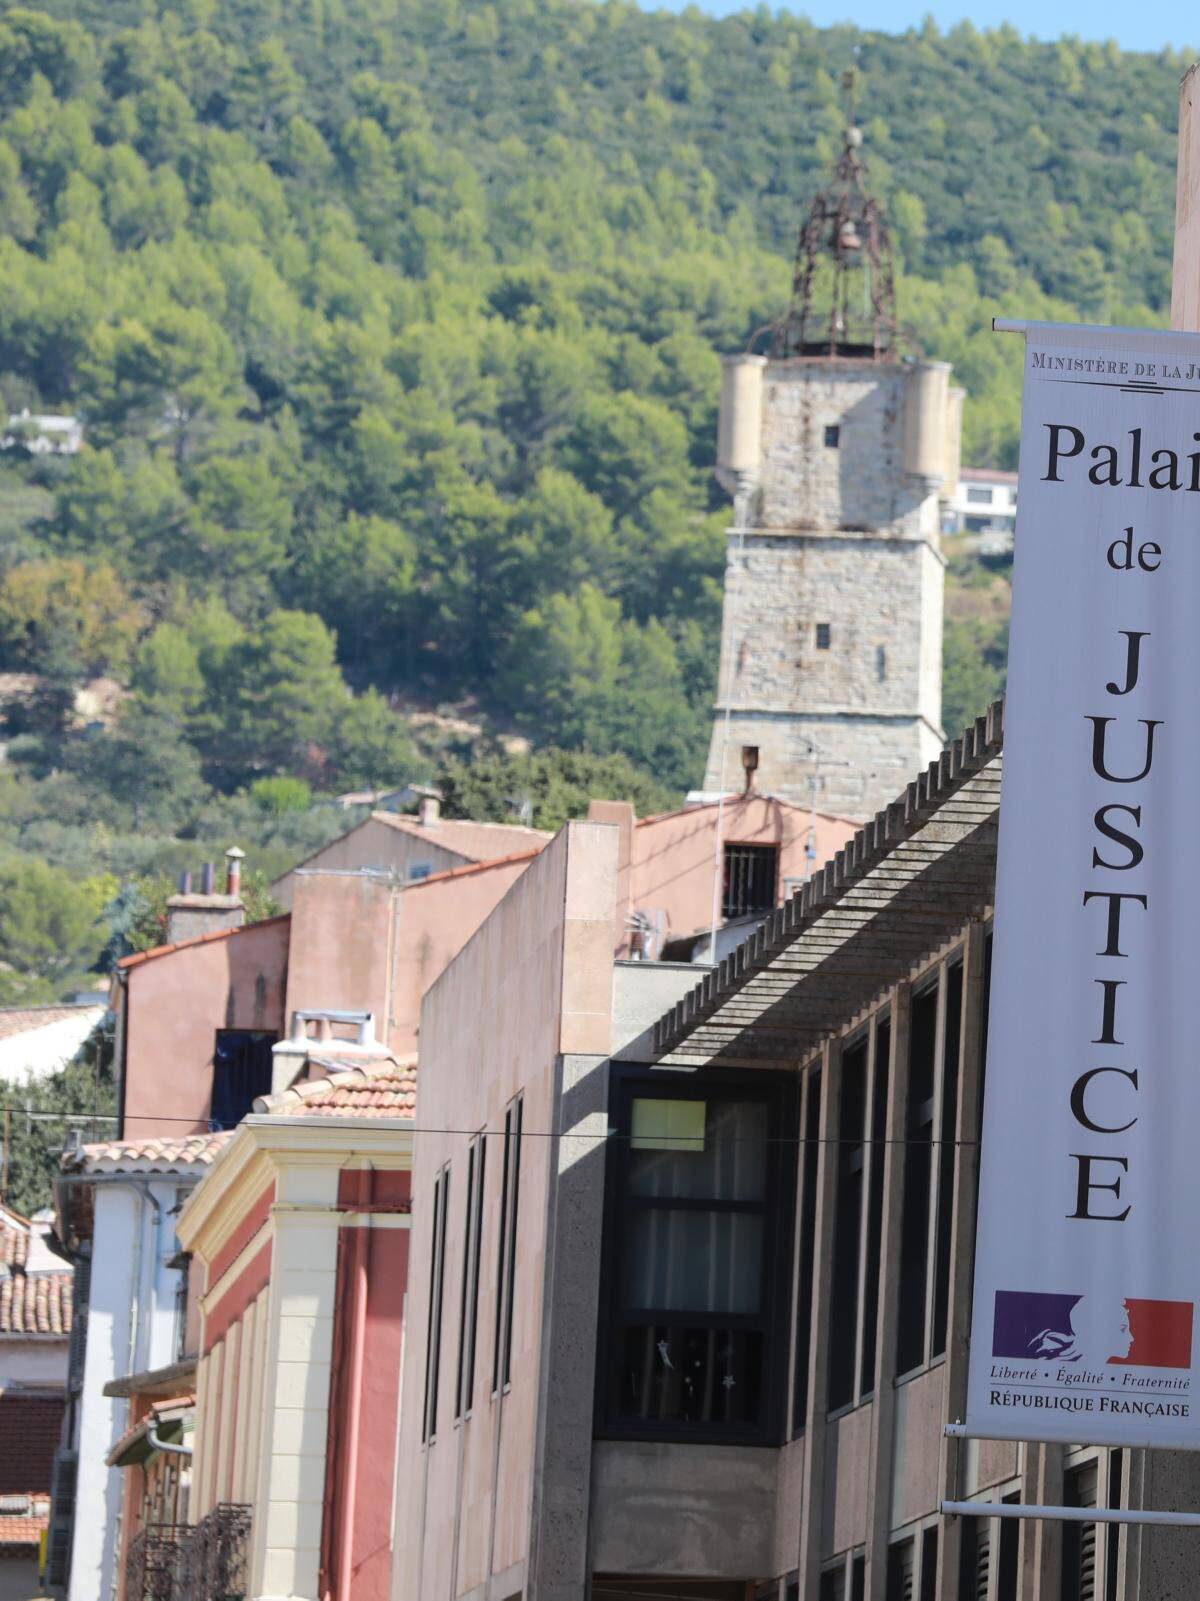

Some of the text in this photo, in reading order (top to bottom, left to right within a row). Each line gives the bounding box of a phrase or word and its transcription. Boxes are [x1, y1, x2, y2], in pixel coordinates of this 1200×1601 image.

[1134, 362, 1156, 377] DE
[1162, 364, 1182, 379] LA
[1107, 526, 1162, 572] de
[1064, 630, 1166, 1222] JUSTICE
[990, 1365, 1192, 1390] Liberté Égalité Fraternité
[989, 1390, 1190, 1418] RÉPUBLIQUE FRANÇAISE
